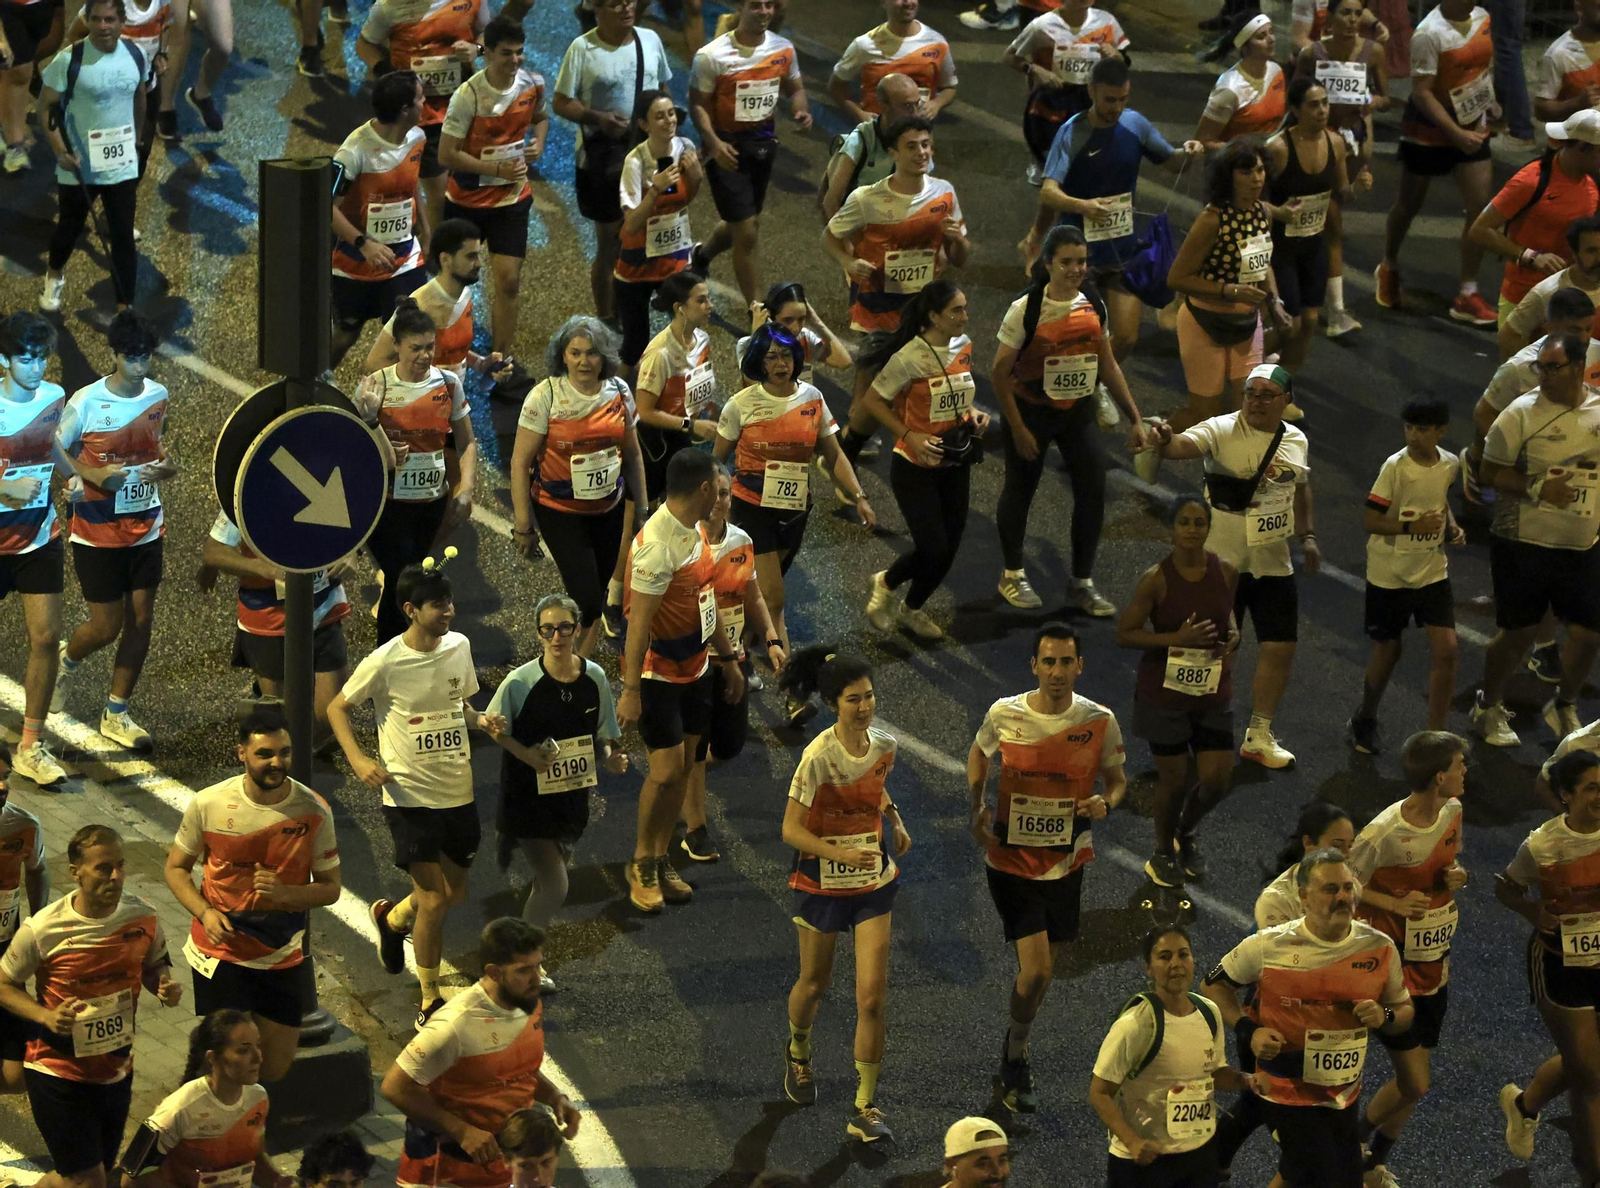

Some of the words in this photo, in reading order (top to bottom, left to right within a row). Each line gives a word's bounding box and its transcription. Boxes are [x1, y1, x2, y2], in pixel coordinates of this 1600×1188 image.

[1059, 59, 1094, 73] 18627
[742, 95, 774, 110] 19748
[103, 144, 124, 159] 993
[373, 217, 408, 233] 19765
[655, 226, 682, 244] 4585
[1248, 253, 1269, 271] 6304
[890, 266, 928, 281] 20217
[1053, 372, 1087, 388] 4582
[688, 381, 712, 403] 10593
[939, 392, 966, 409] 8001
[401, 470, 440, 487] 11840
[586, 469, 609, 488] 787
[777, 480, 799, 497] 782
[1257, 513, 1288, 533] 2602
[1176, 667, 1211, 683] 8887
[415, 730, 461, 750] 16186
[1016, 814, 1064, 832] 16568
[1413, 924, 1453, 947] 16482
[85, 1015, 123, 1040] 7869
[1312, 1051, 1360, 1071] 16629
[1172, 1103, 1211, 1122] 22042
